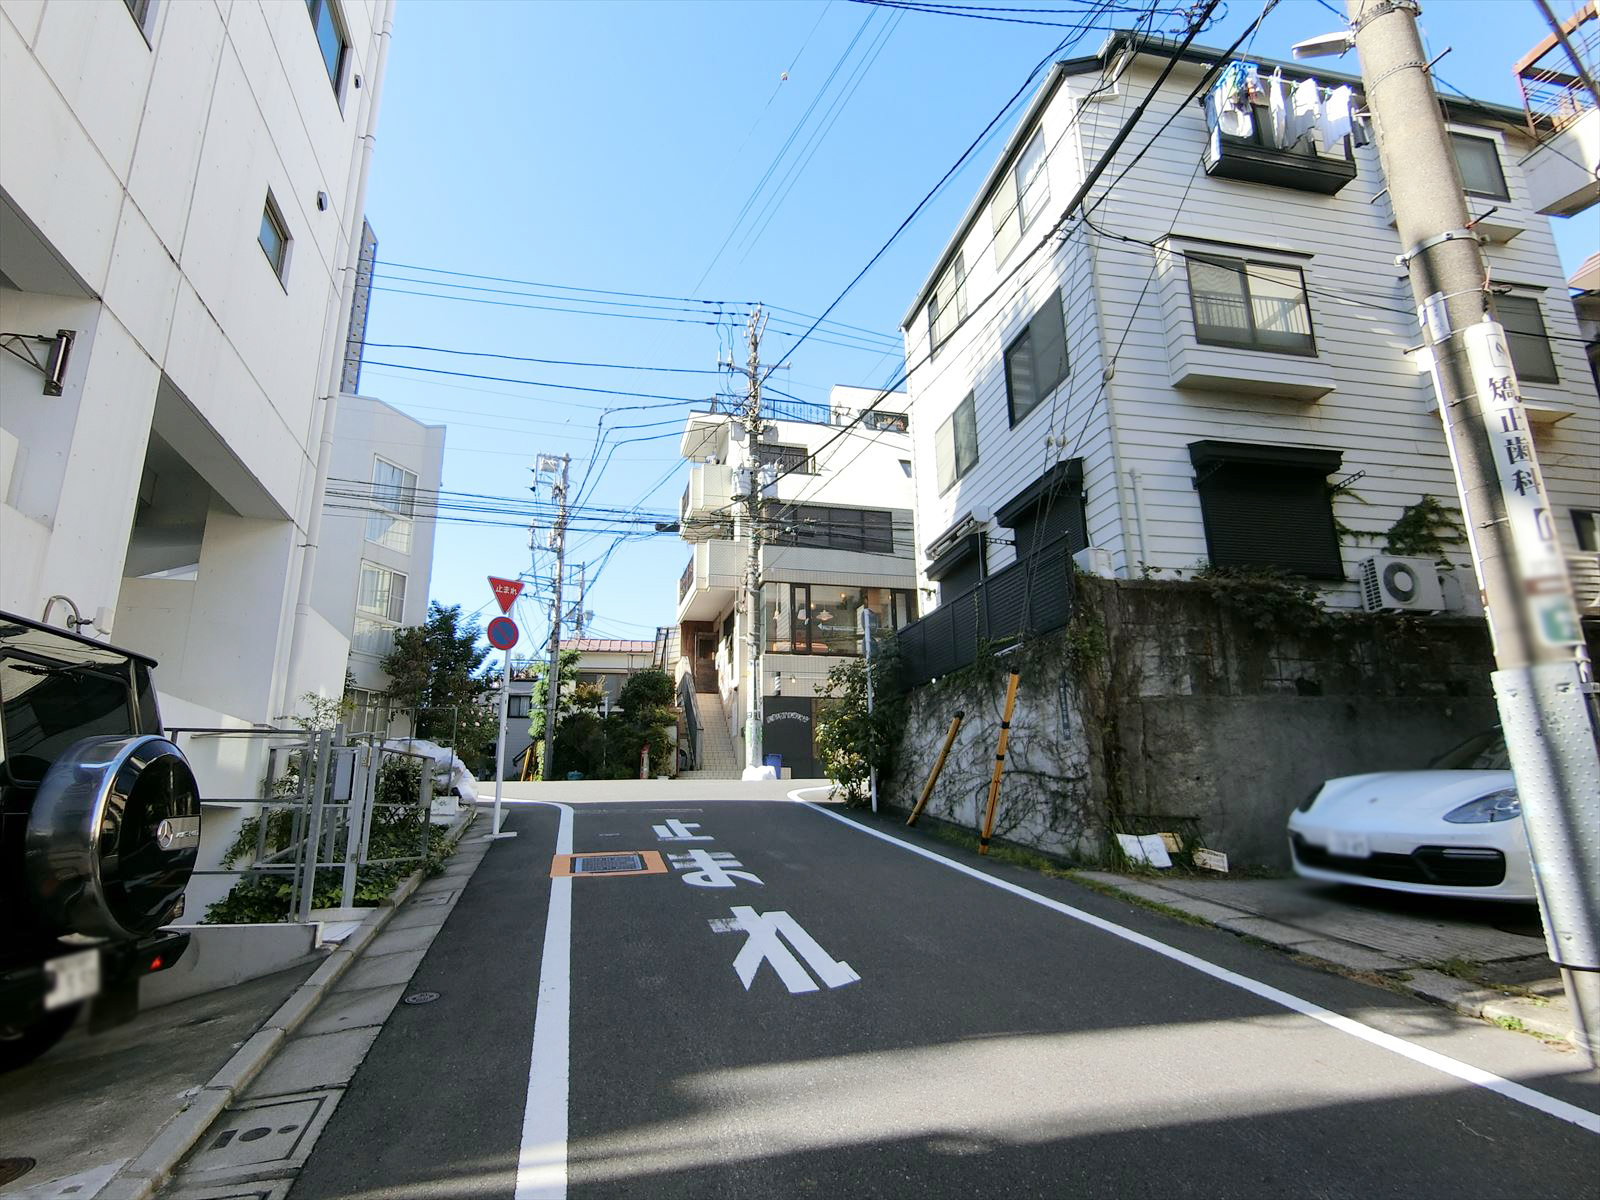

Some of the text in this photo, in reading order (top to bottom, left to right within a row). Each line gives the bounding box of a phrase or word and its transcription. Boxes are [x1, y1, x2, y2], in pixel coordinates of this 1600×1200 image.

[1489, 376, 1540, 496] 矯正歯科
[496, 585, 518, 595] 止まれ
[652, 818, 861, 993] 止まれ
